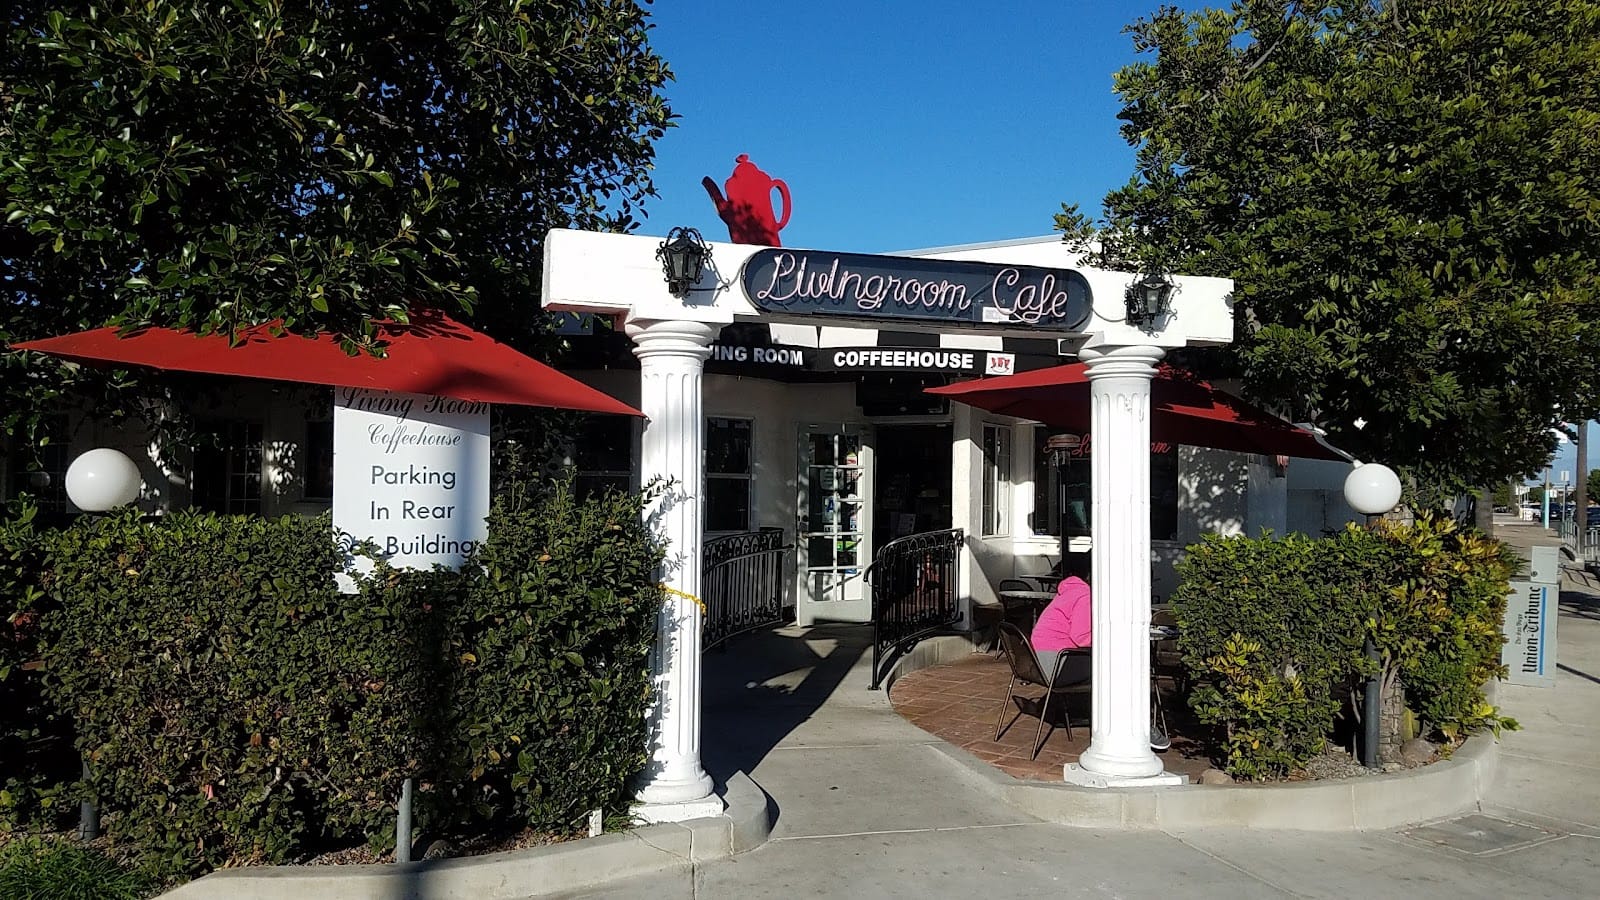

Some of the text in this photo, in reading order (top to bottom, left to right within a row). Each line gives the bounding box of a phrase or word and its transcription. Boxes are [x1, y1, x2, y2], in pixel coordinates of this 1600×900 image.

[991, 267, 1067, 323] Cafe
[753, 347, 803, 365] ROOM
[833, 350, 974, 369] COFFEEHOUSE
[341, 386, 488, 424] Living Room
[367, 423, 462, 454] Coffeehouse
[371, 464, 456, 489] Parking
[371, 500, 455, 520] In Rear
[386, 534, 473, 558] Building
[1522, 586, 1541, 673] Union-Tribune
